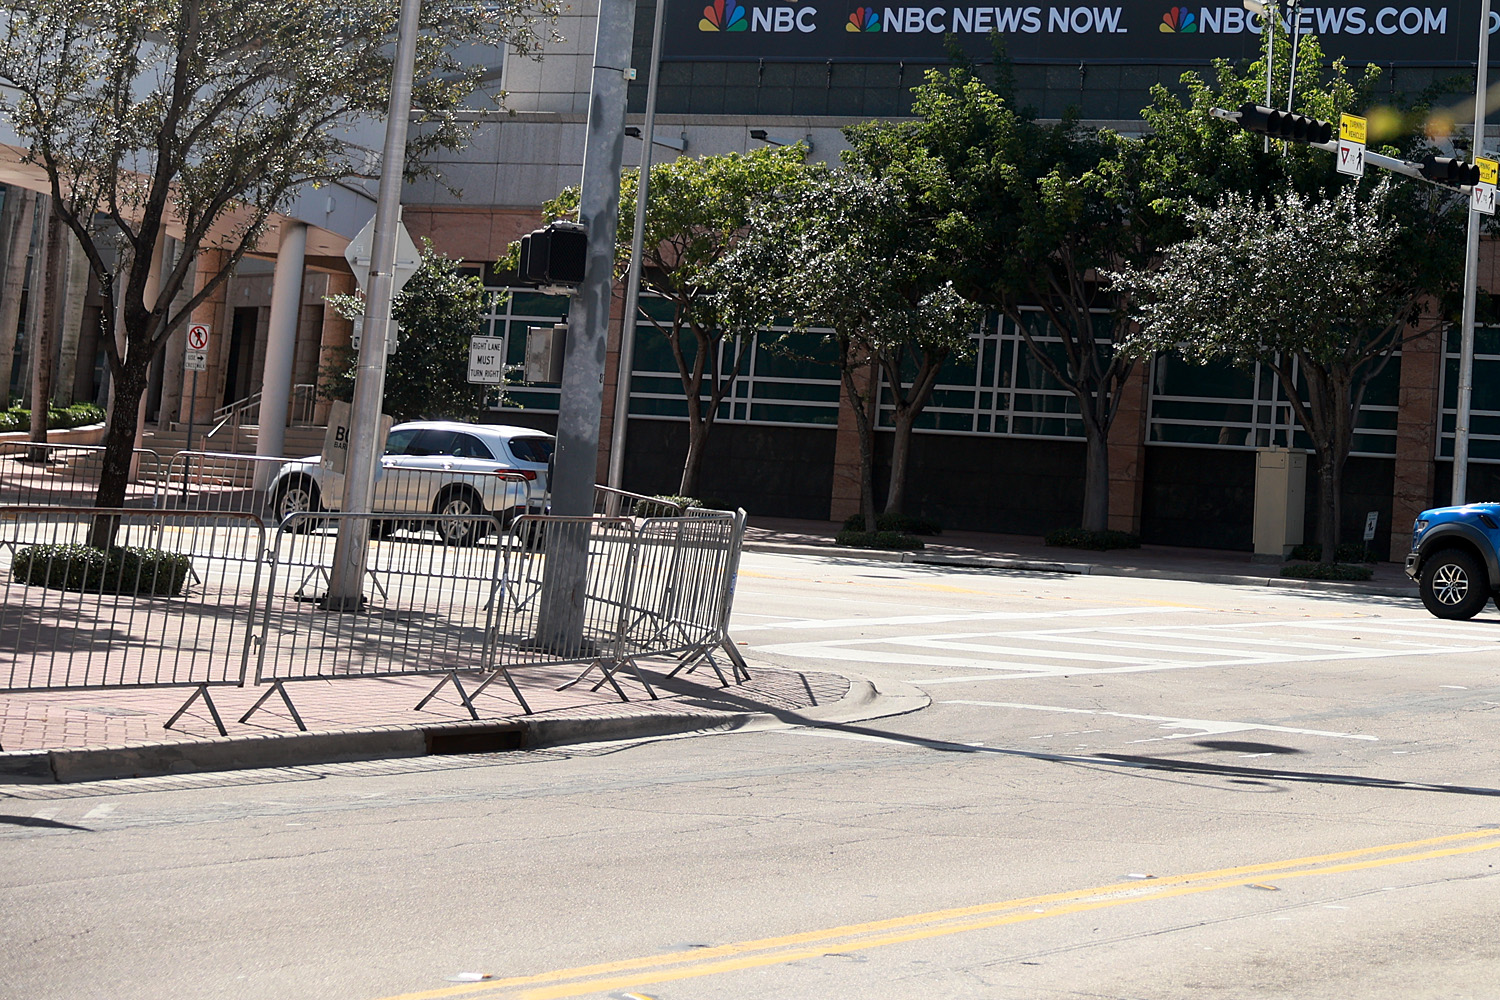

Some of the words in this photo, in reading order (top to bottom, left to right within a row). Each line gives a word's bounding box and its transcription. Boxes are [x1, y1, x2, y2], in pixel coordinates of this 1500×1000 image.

[751, 7, 818, 33] NBC
[883, 7, 947, 33] NBC
[952, 6, 1042, 34] NEWS
[472, 341, 487, 350] RIGHT
[488, 343, 501, 351] LANE
[477, 355, 495, 365] MUST
[470, 369, 483, 377] TURN
[484, 370, 499, 378] RIGHT
